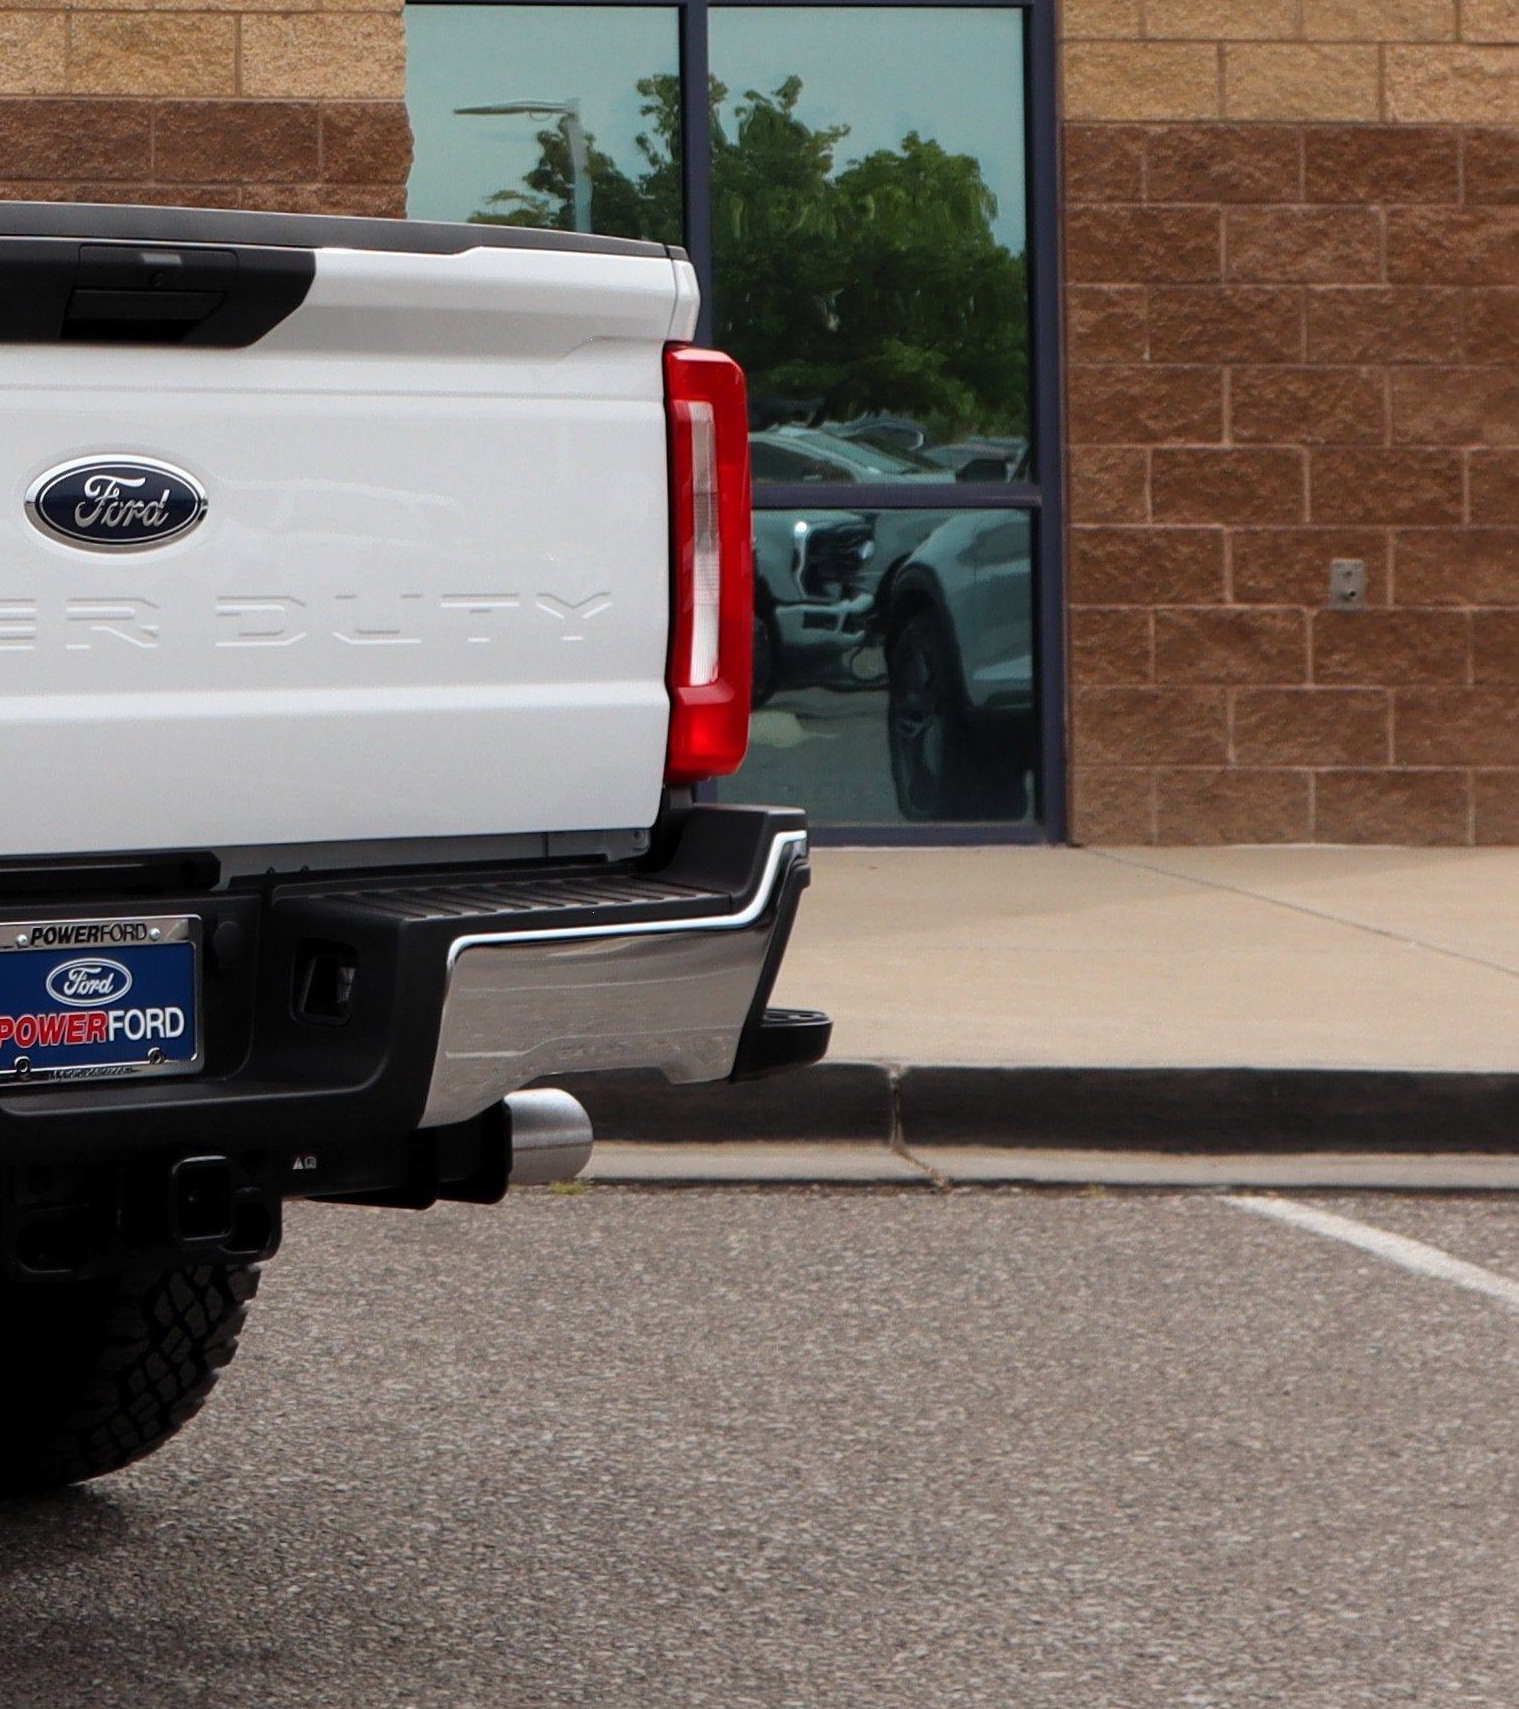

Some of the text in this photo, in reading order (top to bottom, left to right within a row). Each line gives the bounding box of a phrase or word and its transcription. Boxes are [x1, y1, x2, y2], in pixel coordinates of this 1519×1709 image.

[74, 474, 170, 528] Ford
[215, 592, 612, 647] DUTY
[30, 923, 148, 946] POWERFORD
[63, 966, 114, 997] Ford
